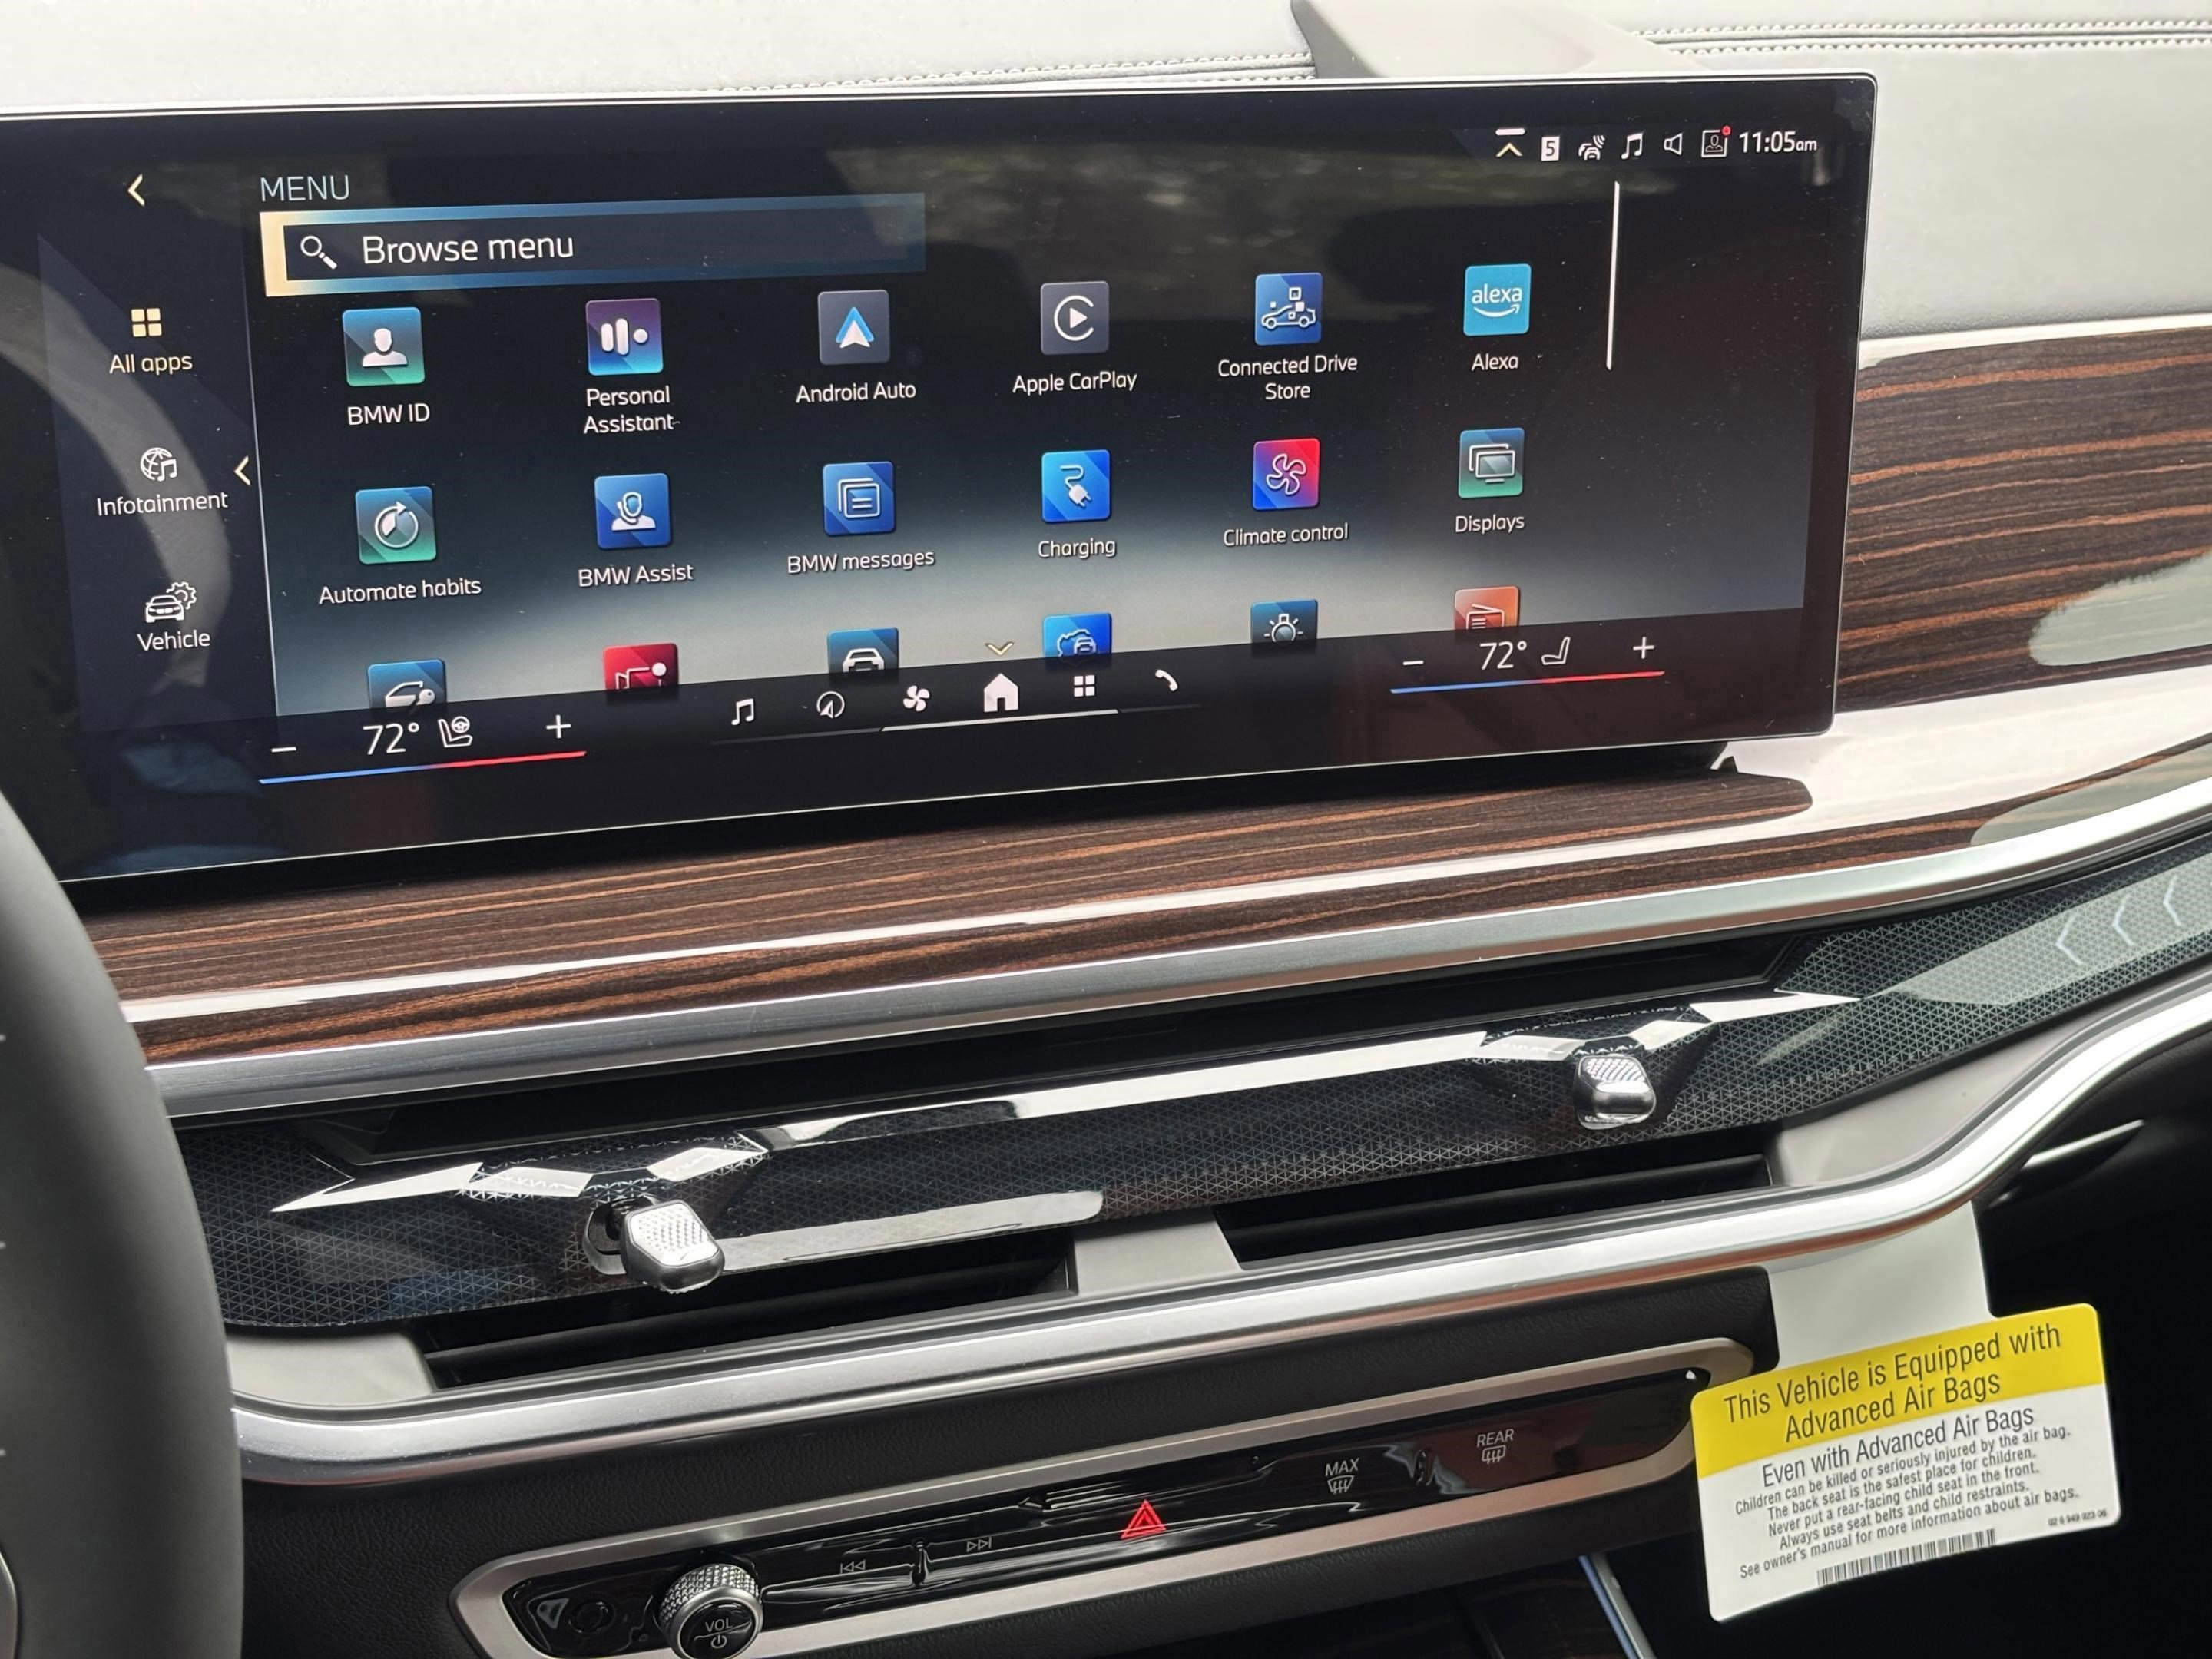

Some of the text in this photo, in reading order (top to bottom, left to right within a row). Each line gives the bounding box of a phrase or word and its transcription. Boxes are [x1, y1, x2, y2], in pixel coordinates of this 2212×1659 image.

[1545, 141, 1555, 156] 5
[260, 175, 350, 202] MENU
[363, 236, 574, 264] Browse menu
[1472, 284, 1522, 303] alexa
[109, 353, 193, 376] All apps
[1218, 355, 1358, 377] Connected Drive
[1471, 353, 1518, 370] Alexa
[796, 382, 916, 404] Android Auto
[1012, 371, 1137, 396] Apple CarPlay
[1265, 382, 1310, 399] Store
[586, 386, 670, 407] Personal
[347, 402, 430, 426] BMW ID
[583, 413, 675, 435] Assistant
[97, 492, 228, 516] Infotainment
[1224, 523, 1348, 546] Climate control
[1455, 514, 1524, 534] Displays
[1038, 538, 1116, 558] Charging
[787, 550, 934, 575] BMW messages
[578, 564, 694, 588] BMW Assist
[319, 578, 482, 605] Automate habits
[137, 630, 210, 651] Vehicle
[1724, 1323, 2060, 1422] This Vehicle is Equipped with
[1786, 1373, 2000, 1442] Advanced Air Bags
[1476, 1429, 1514, 1448] REAR
[1763, 1408, 2034, 1487] Even with Advanced Air Bags
[1325, 1458, 1359, 1476] MAX
[1736, 1426, 2071, 1515] Children can be killed or seriously injured by the air bag.
[1768, 1448, 2037, 1521] The back seat is the safest place for children.
[1769, 1462, 2039, 1537] Never put a rear-facing child seat in the front.
[1780, 1479, 2029, 1551] Always use seat belts and child restraints.
[1740, 1487, 2079, 1579] See owner's manual for more information about air bags.
[705, 1618, 732, 1632] VOL
